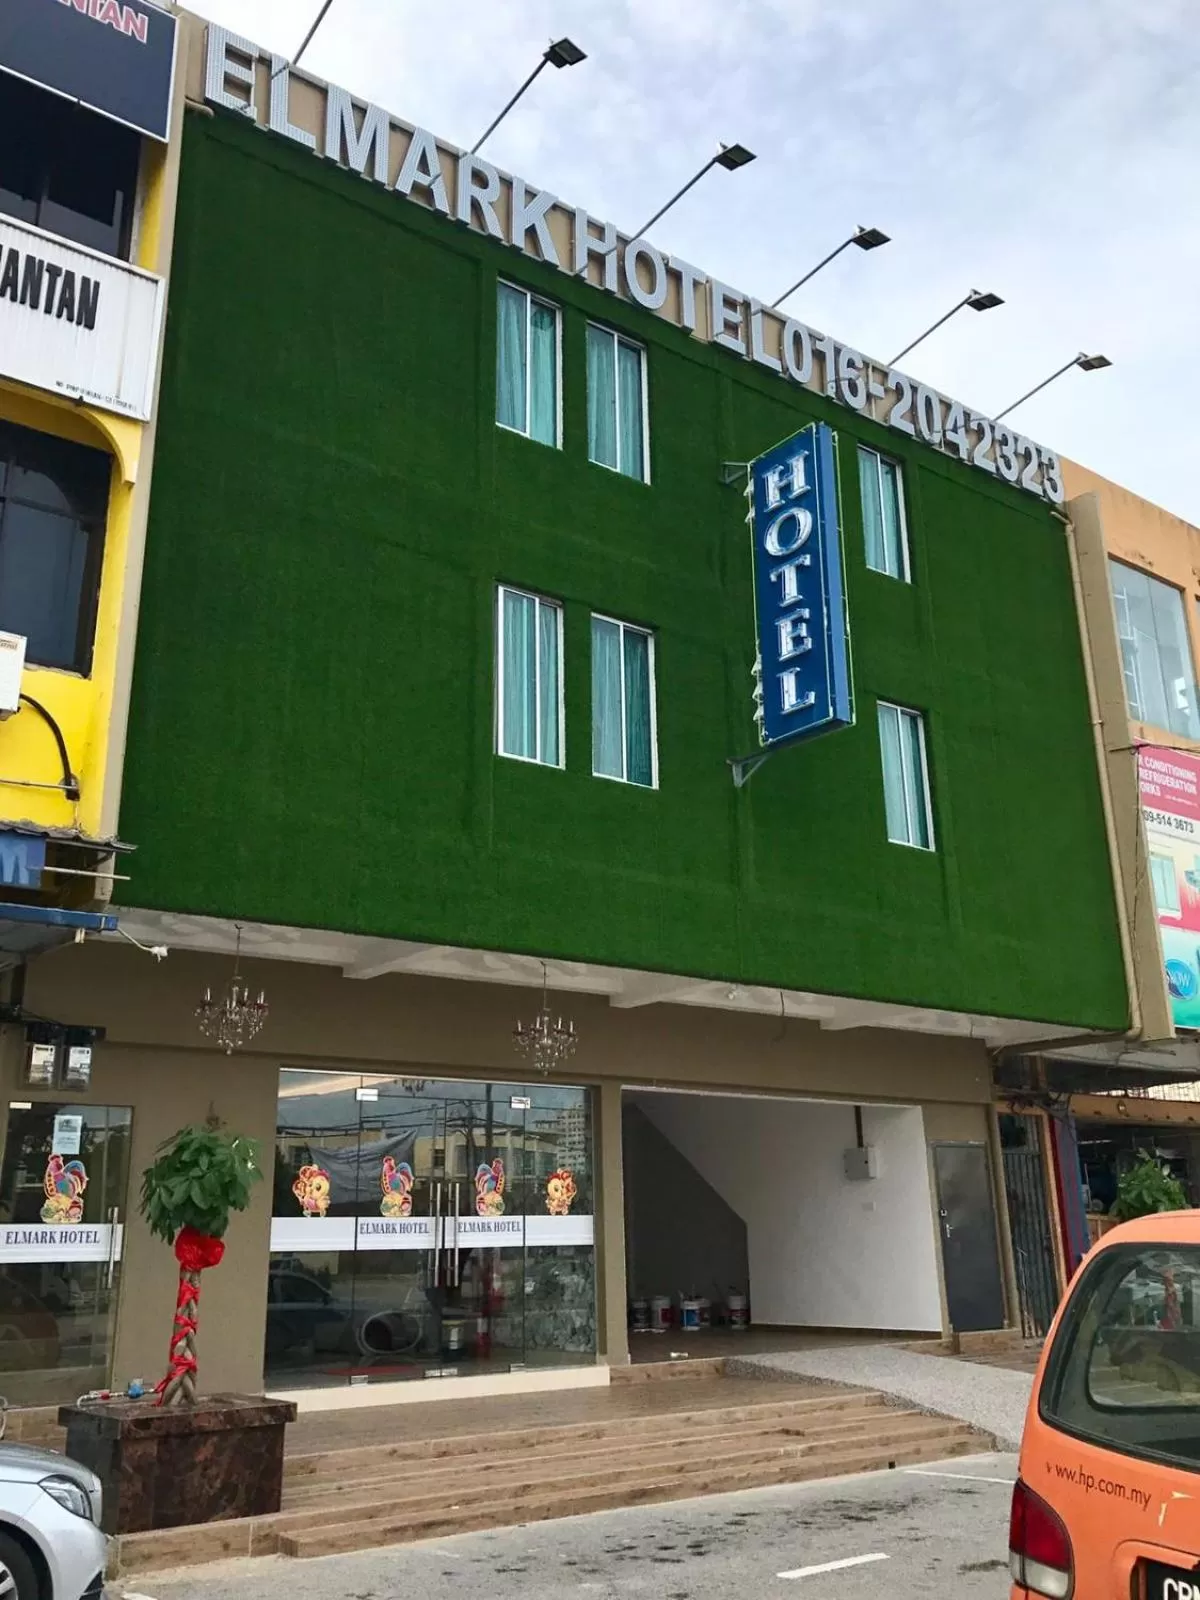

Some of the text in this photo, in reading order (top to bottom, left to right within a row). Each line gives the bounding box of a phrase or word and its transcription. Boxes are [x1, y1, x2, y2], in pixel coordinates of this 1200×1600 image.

[205, 22, 1066, 503] ELMARK HOTEL 016-2042323
[0, 246, 100, 331] ANTAN
[763, 450, 816, 715] HOTEL
[1140, 781, 1161, 796] ORKS
[359, 1221, 430, 1235] ELMARK HOTEL
[458, 1220, 521, 1233] ELMARK HOTEL
[5, 1230, 100, 1245] ELMARK HOTEL
